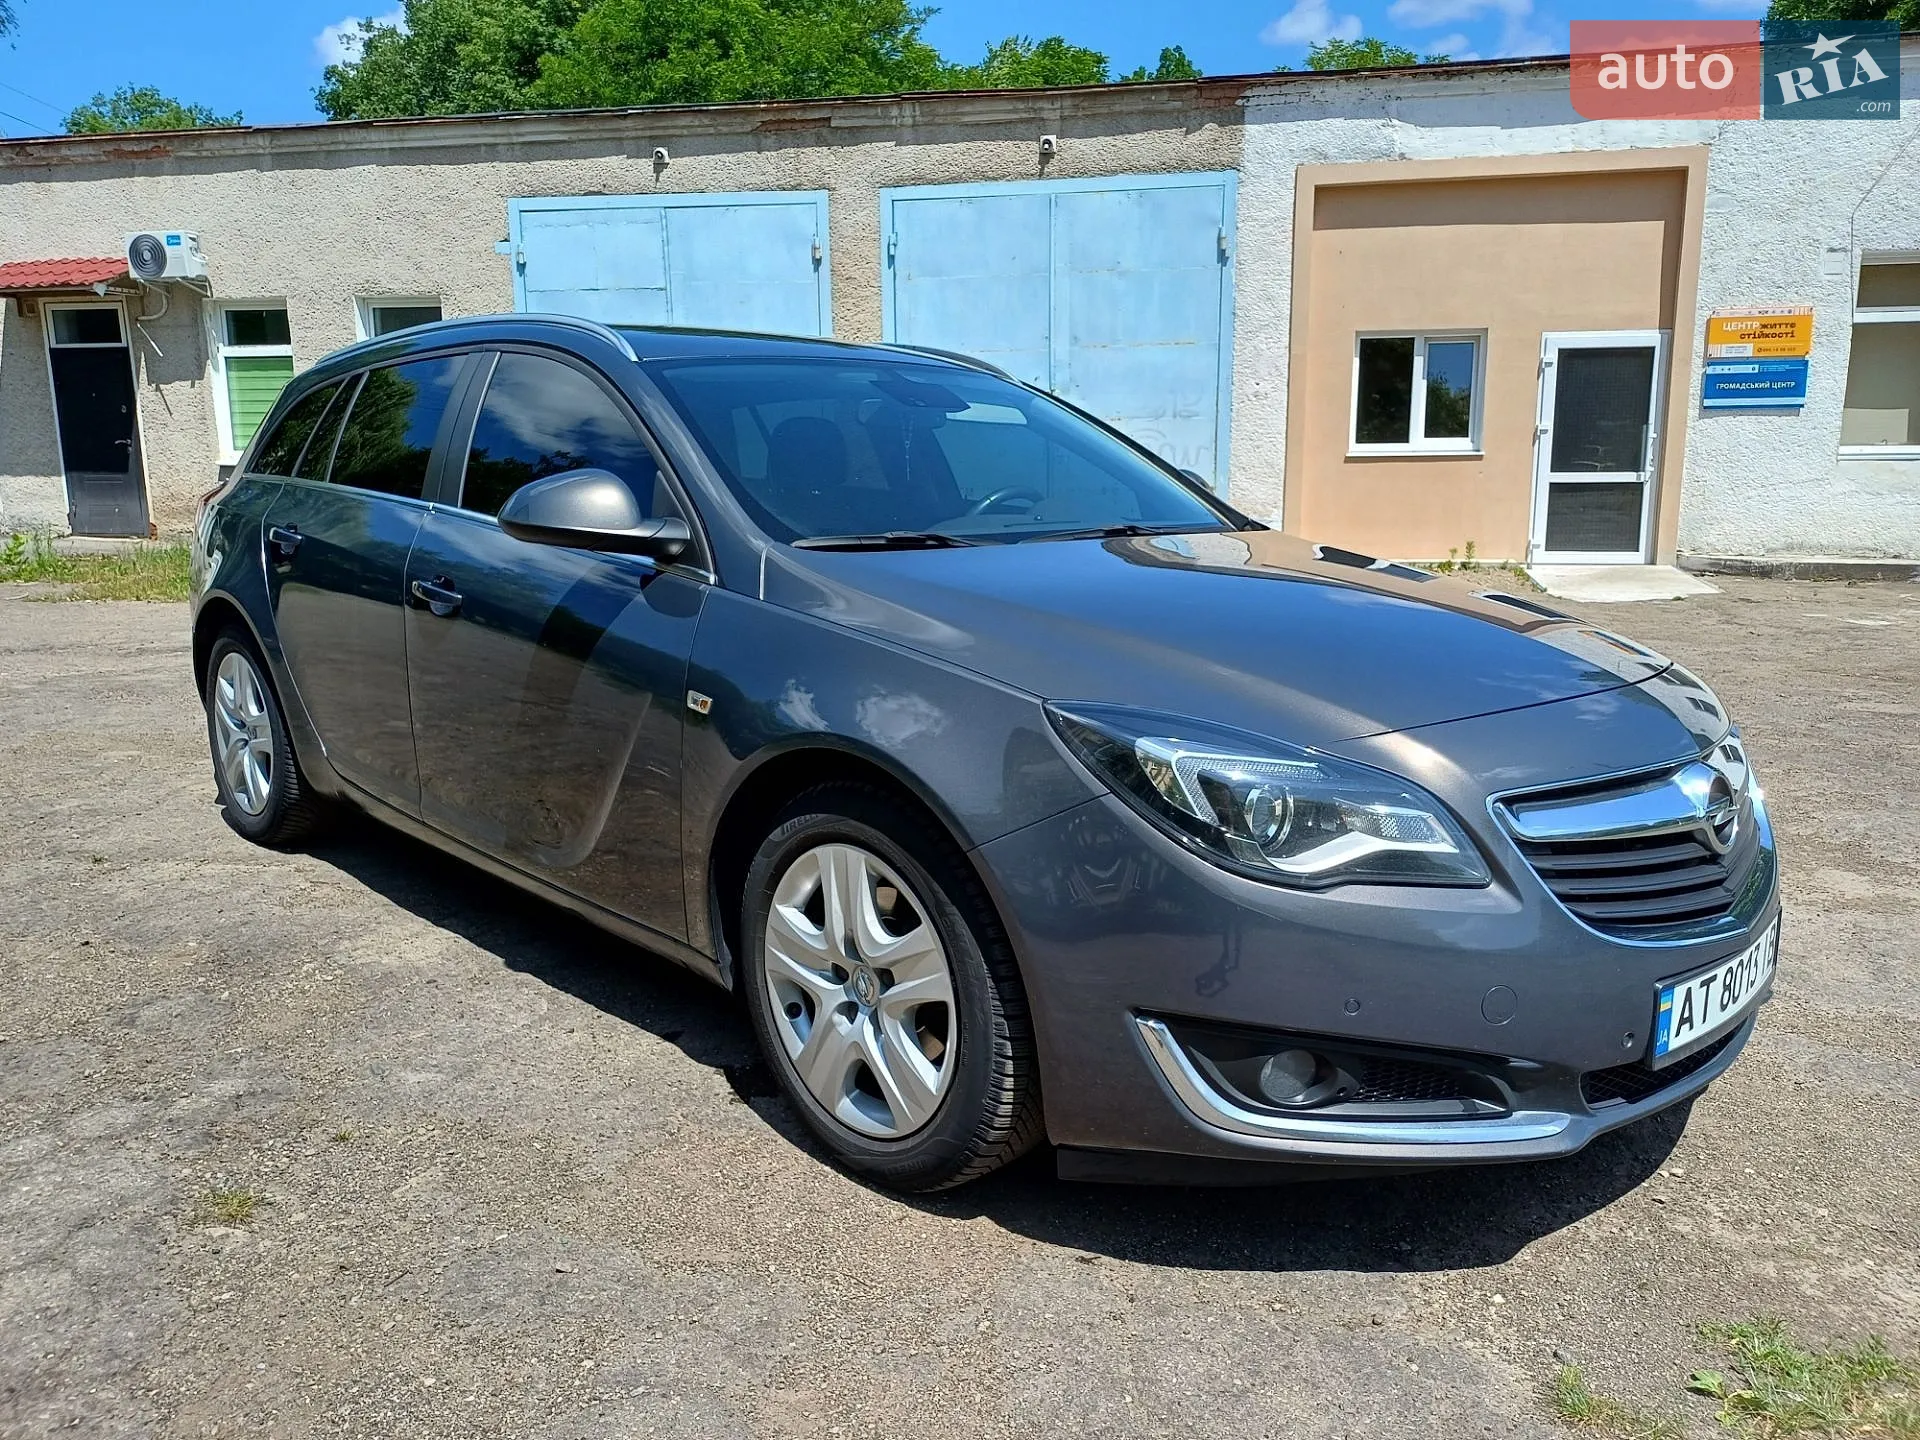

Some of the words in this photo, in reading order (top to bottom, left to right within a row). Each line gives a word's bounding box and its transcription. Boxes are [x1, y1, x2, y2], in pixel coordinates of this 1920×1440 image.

[1723, 322, 1760, 331] ЦЕНТР
[1740, 330, 1796, 339] стійкості
[1716, 381, 1770, 390] ГРОМАДСЬКИЙ
[1771, 381, 1795, 389] ЦЕНТР
[1675, 974, 1717, 1038] AT
[1720, 943, 1760, 1012] 8013
[1762, 923, 1775, 976] IB
